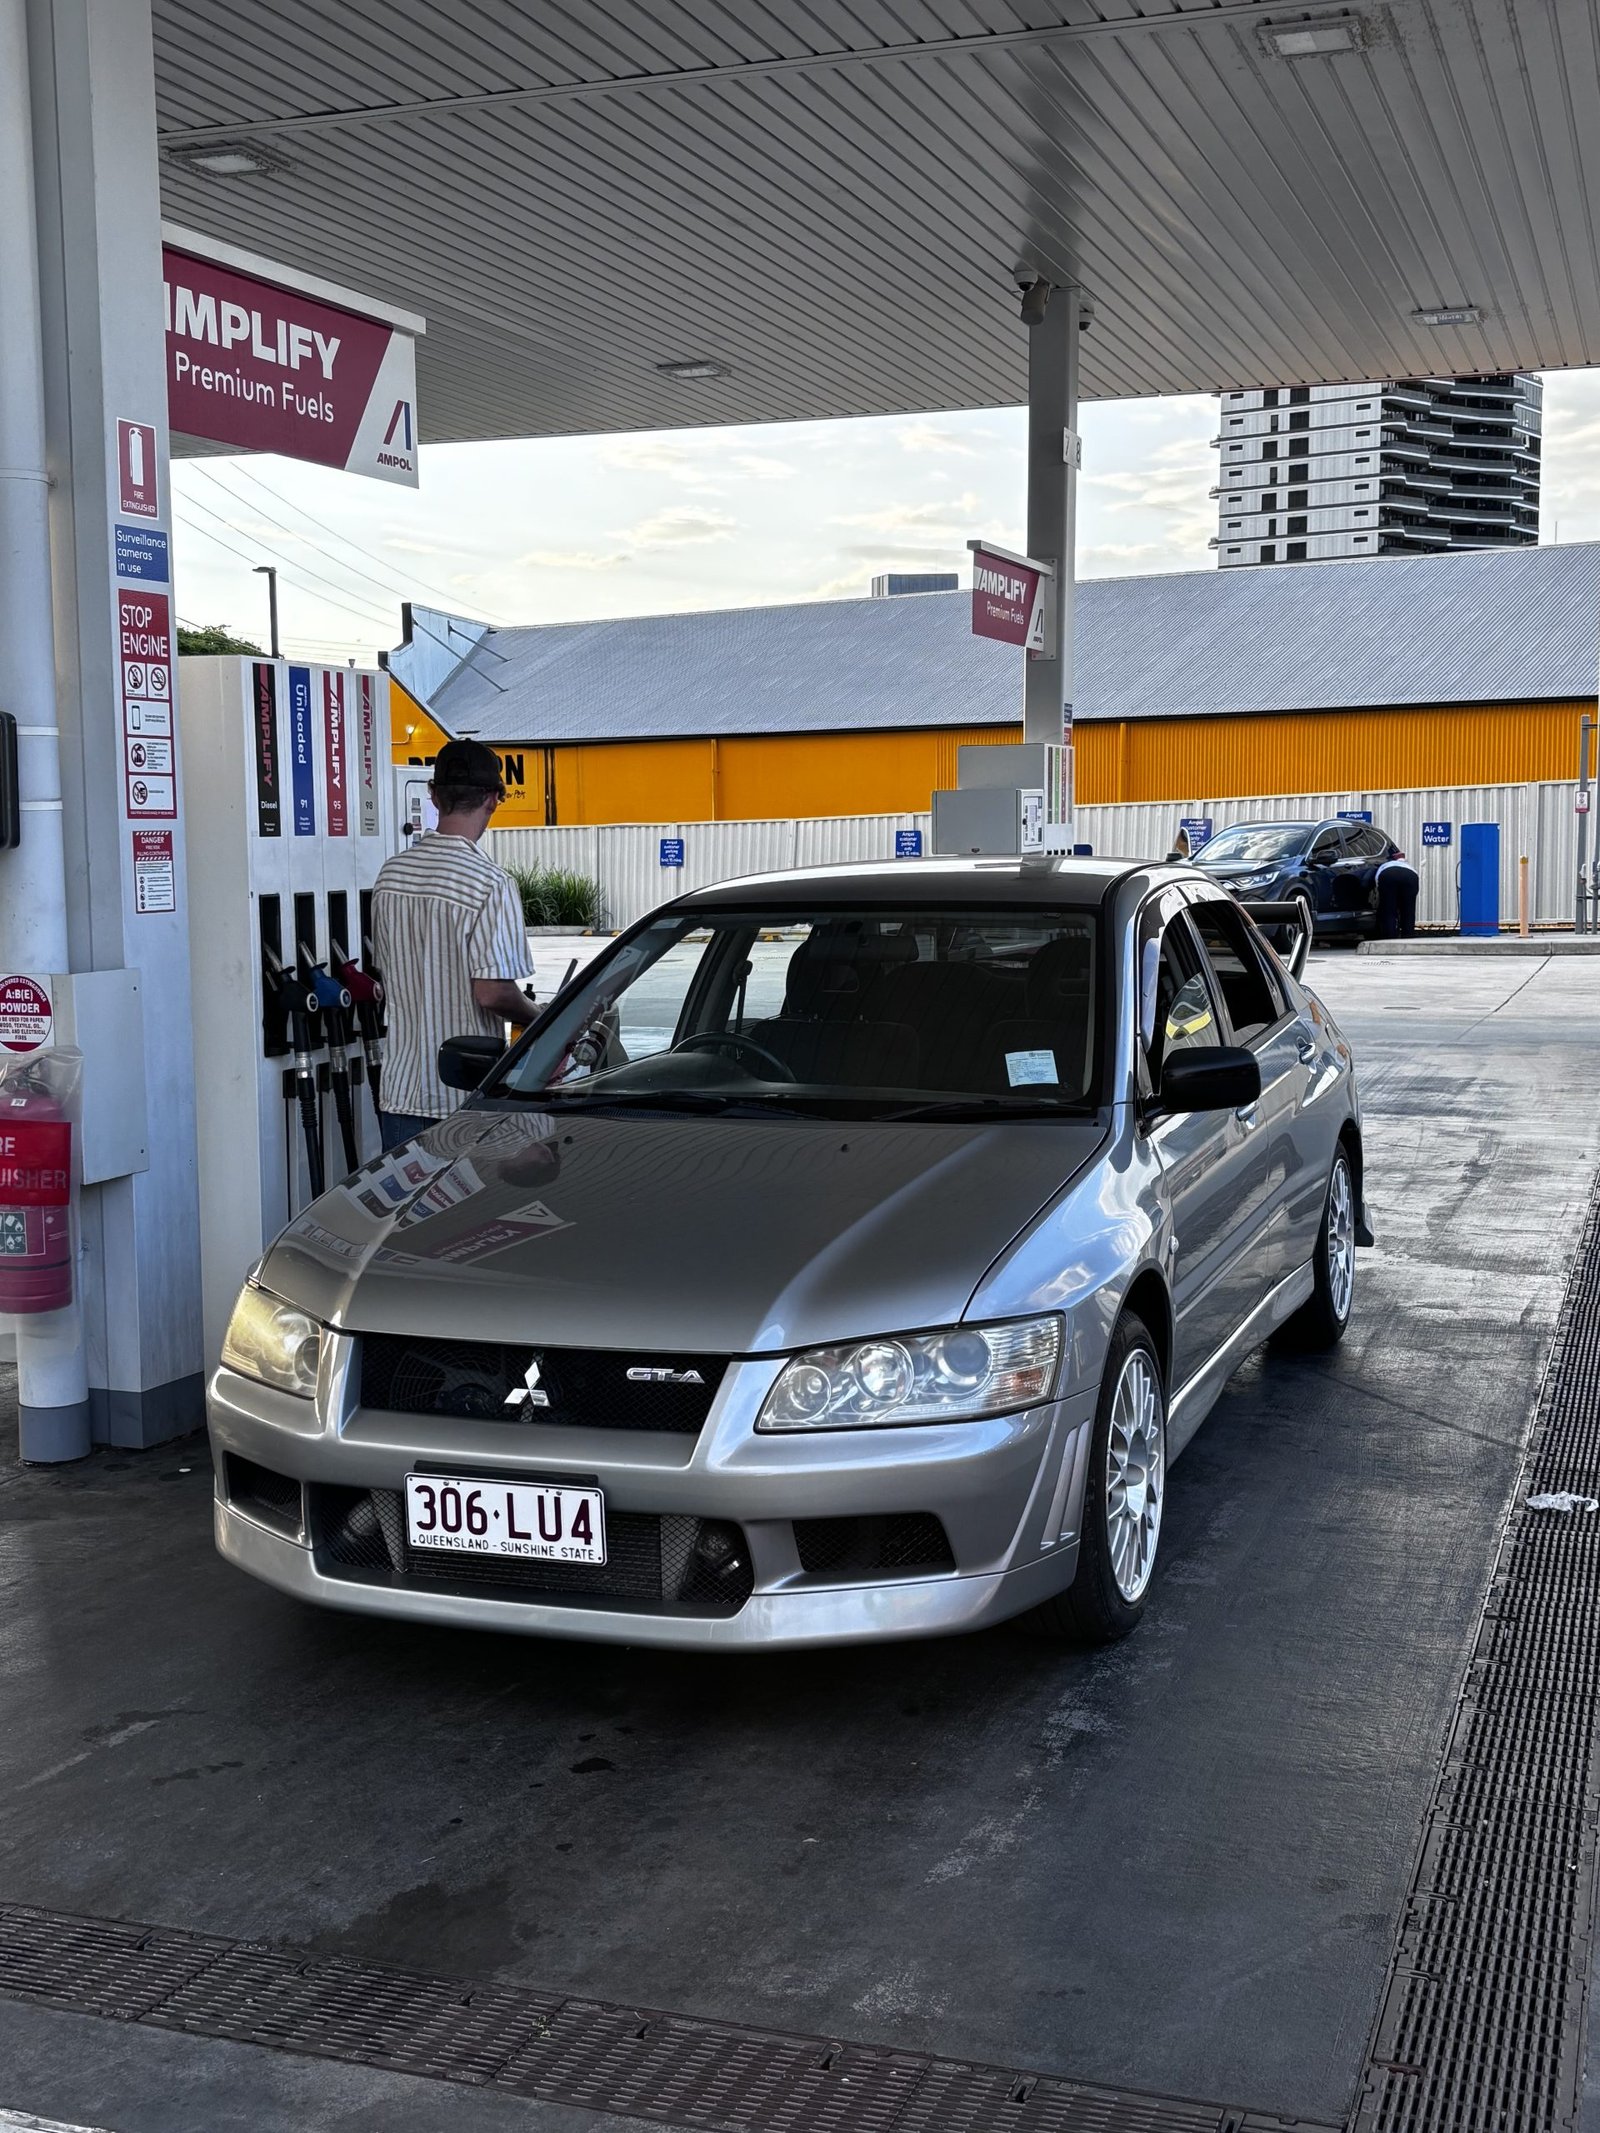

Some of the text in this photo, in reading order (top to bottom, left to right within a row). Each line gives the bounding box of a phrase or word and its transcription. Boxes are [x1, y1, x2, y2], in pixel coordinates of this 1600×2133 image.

[175, 351, 334, 424] Premium Fuels
[377, 452, 412, 471] AMPOL
[133, 490, 144, 500] FIRE
[122, 499, 156, 513] EXTINGUISHER
[117, 530, 167, 549] Surveillance
[117, 547, 153, 561] cameras
[118, 559, 142, 574] in use
[979, 568, 1027, 604] AMPLIFY
[121, 604, 152, 628] STOP
[986, 600, 1024, 625] Premium Fuels
[122, 632, 168, 658] ENGINE
[296, 683, 307, 764] Unleaded
[260, 684, 273, 788] AMPLIFY
[330, 692, 341, 789] AMPLIFY
[362, 696, 373, 790] AMPLIFY
[261, 800, 278, 809] Diesel
[300, 799, 308, 809] 91
[333, 800, 341, 810] 95
[365, 800, 373, 810] 98
[1424, 825, 1444, 833] Air &
[141, 836, 165, 844] DANGER
[1424, 835, 1449, 843] Water
[5, 988, 34, 1002] A:B(E)
[0, 1002, 40, 1014] POWDER
[626, 1367, 706, 1384] GT-A
[418, 1533, 489, 1551] QUEENSLAND
[500, 1541, 555, 1557] SUNSHINE
[561, 1546, 595, 1561] STATE
